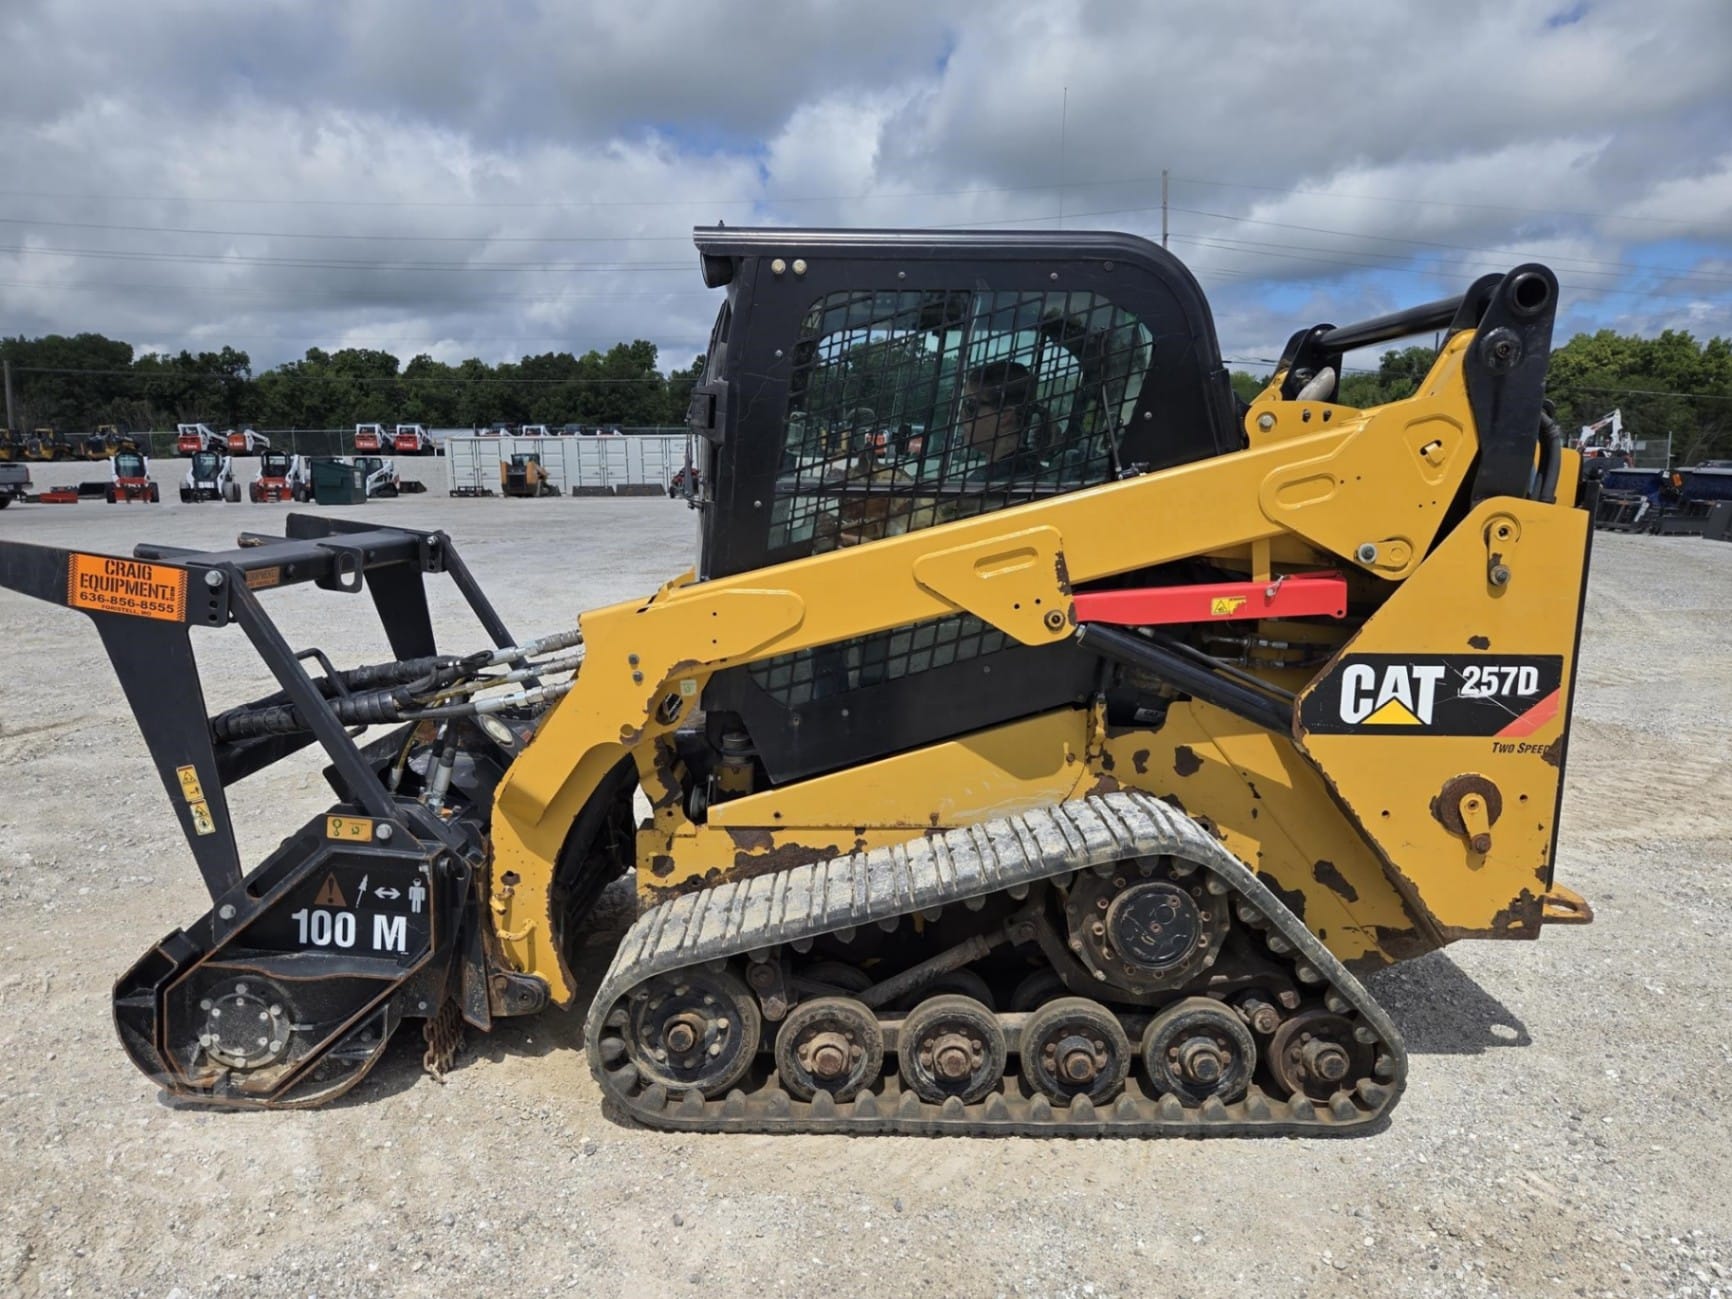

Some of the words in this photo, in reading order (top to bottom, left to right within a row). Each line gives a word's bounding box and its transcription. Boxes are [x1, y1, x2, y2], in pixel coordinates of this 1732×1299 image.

[105, 560, 152, 581] CRAIG
[79, 591, 175, 614] 636-856-8555
[1339, 663, 1446, 726] CAT
[1461, 665, 1540, 697] 257D
[291, 908, 356, 948] 100
[372, 913, 408, 952] M
